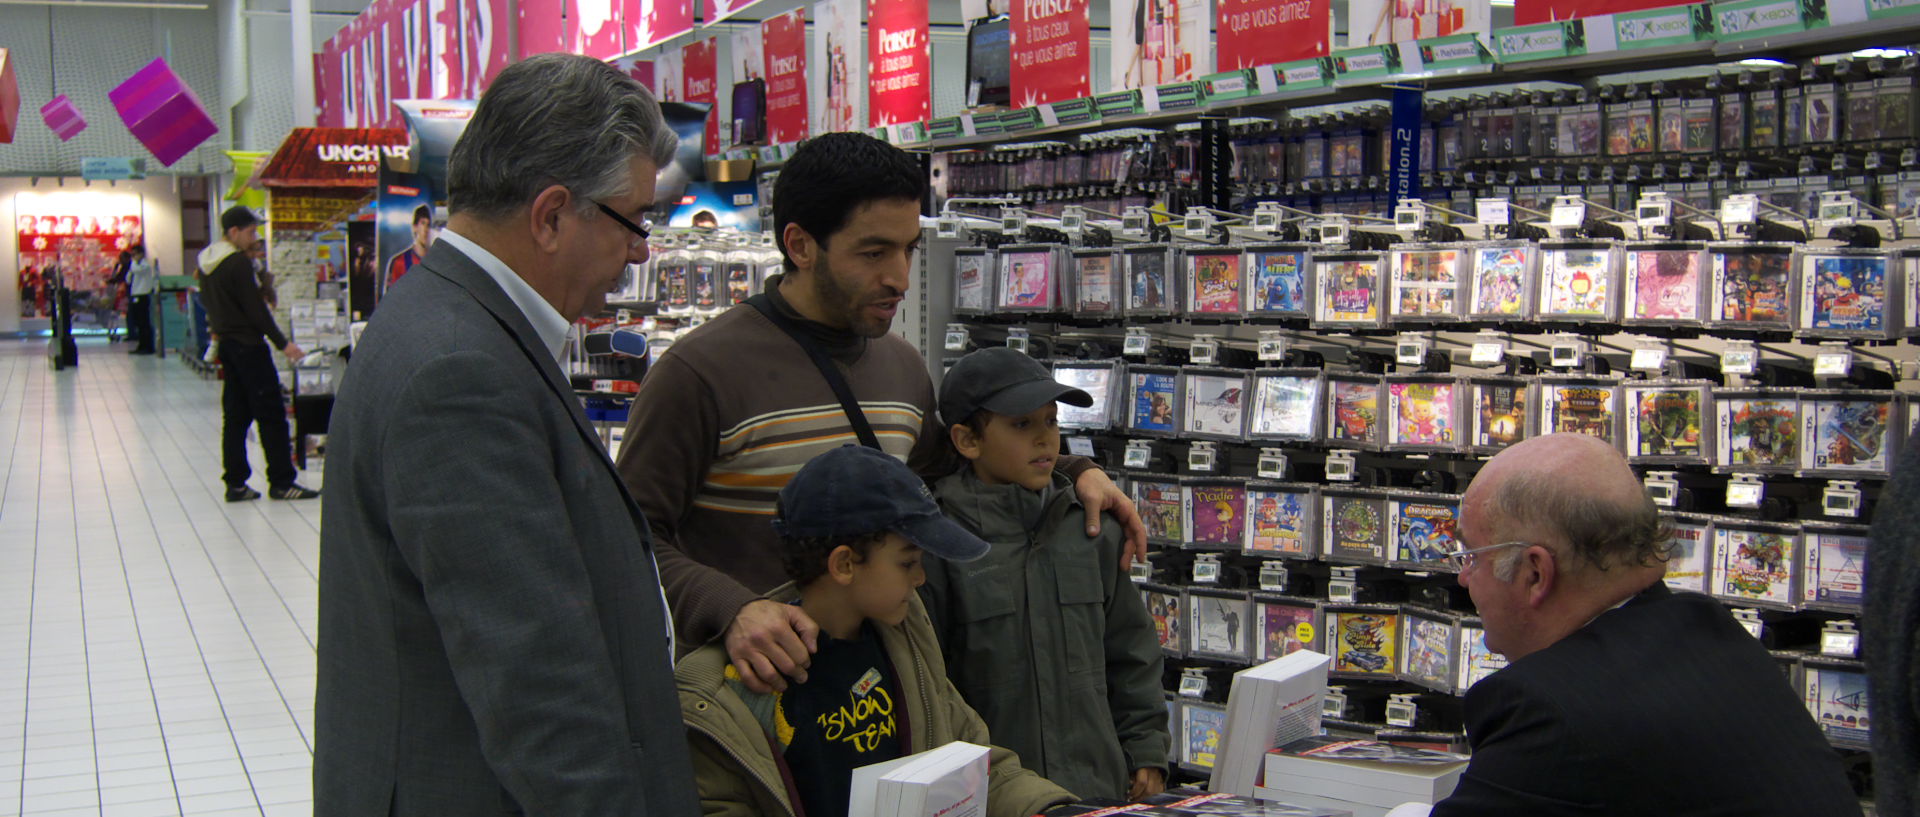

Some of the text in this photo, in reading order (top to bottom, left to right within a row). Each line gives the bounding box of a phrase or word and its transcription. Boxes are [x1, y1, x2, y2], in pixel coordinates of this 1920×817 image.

[1231, 0, 1311, 36] que vous aimez
[878, 28, 917, 54] Pensez
[1026, 21, 1071, 44] à tous ceux
[771, 55, 798, 77] Pensez
[887, 56, 900, 72] tous
[900, 54, 914, 69] ceux
[1020, 41, 1078, 71] que vous aimez
[687, 77, 711, 97] Pensez
[875, 72, 920, 95] que vous aimez
[1409, 506, 1451, 516] DRAGONS
